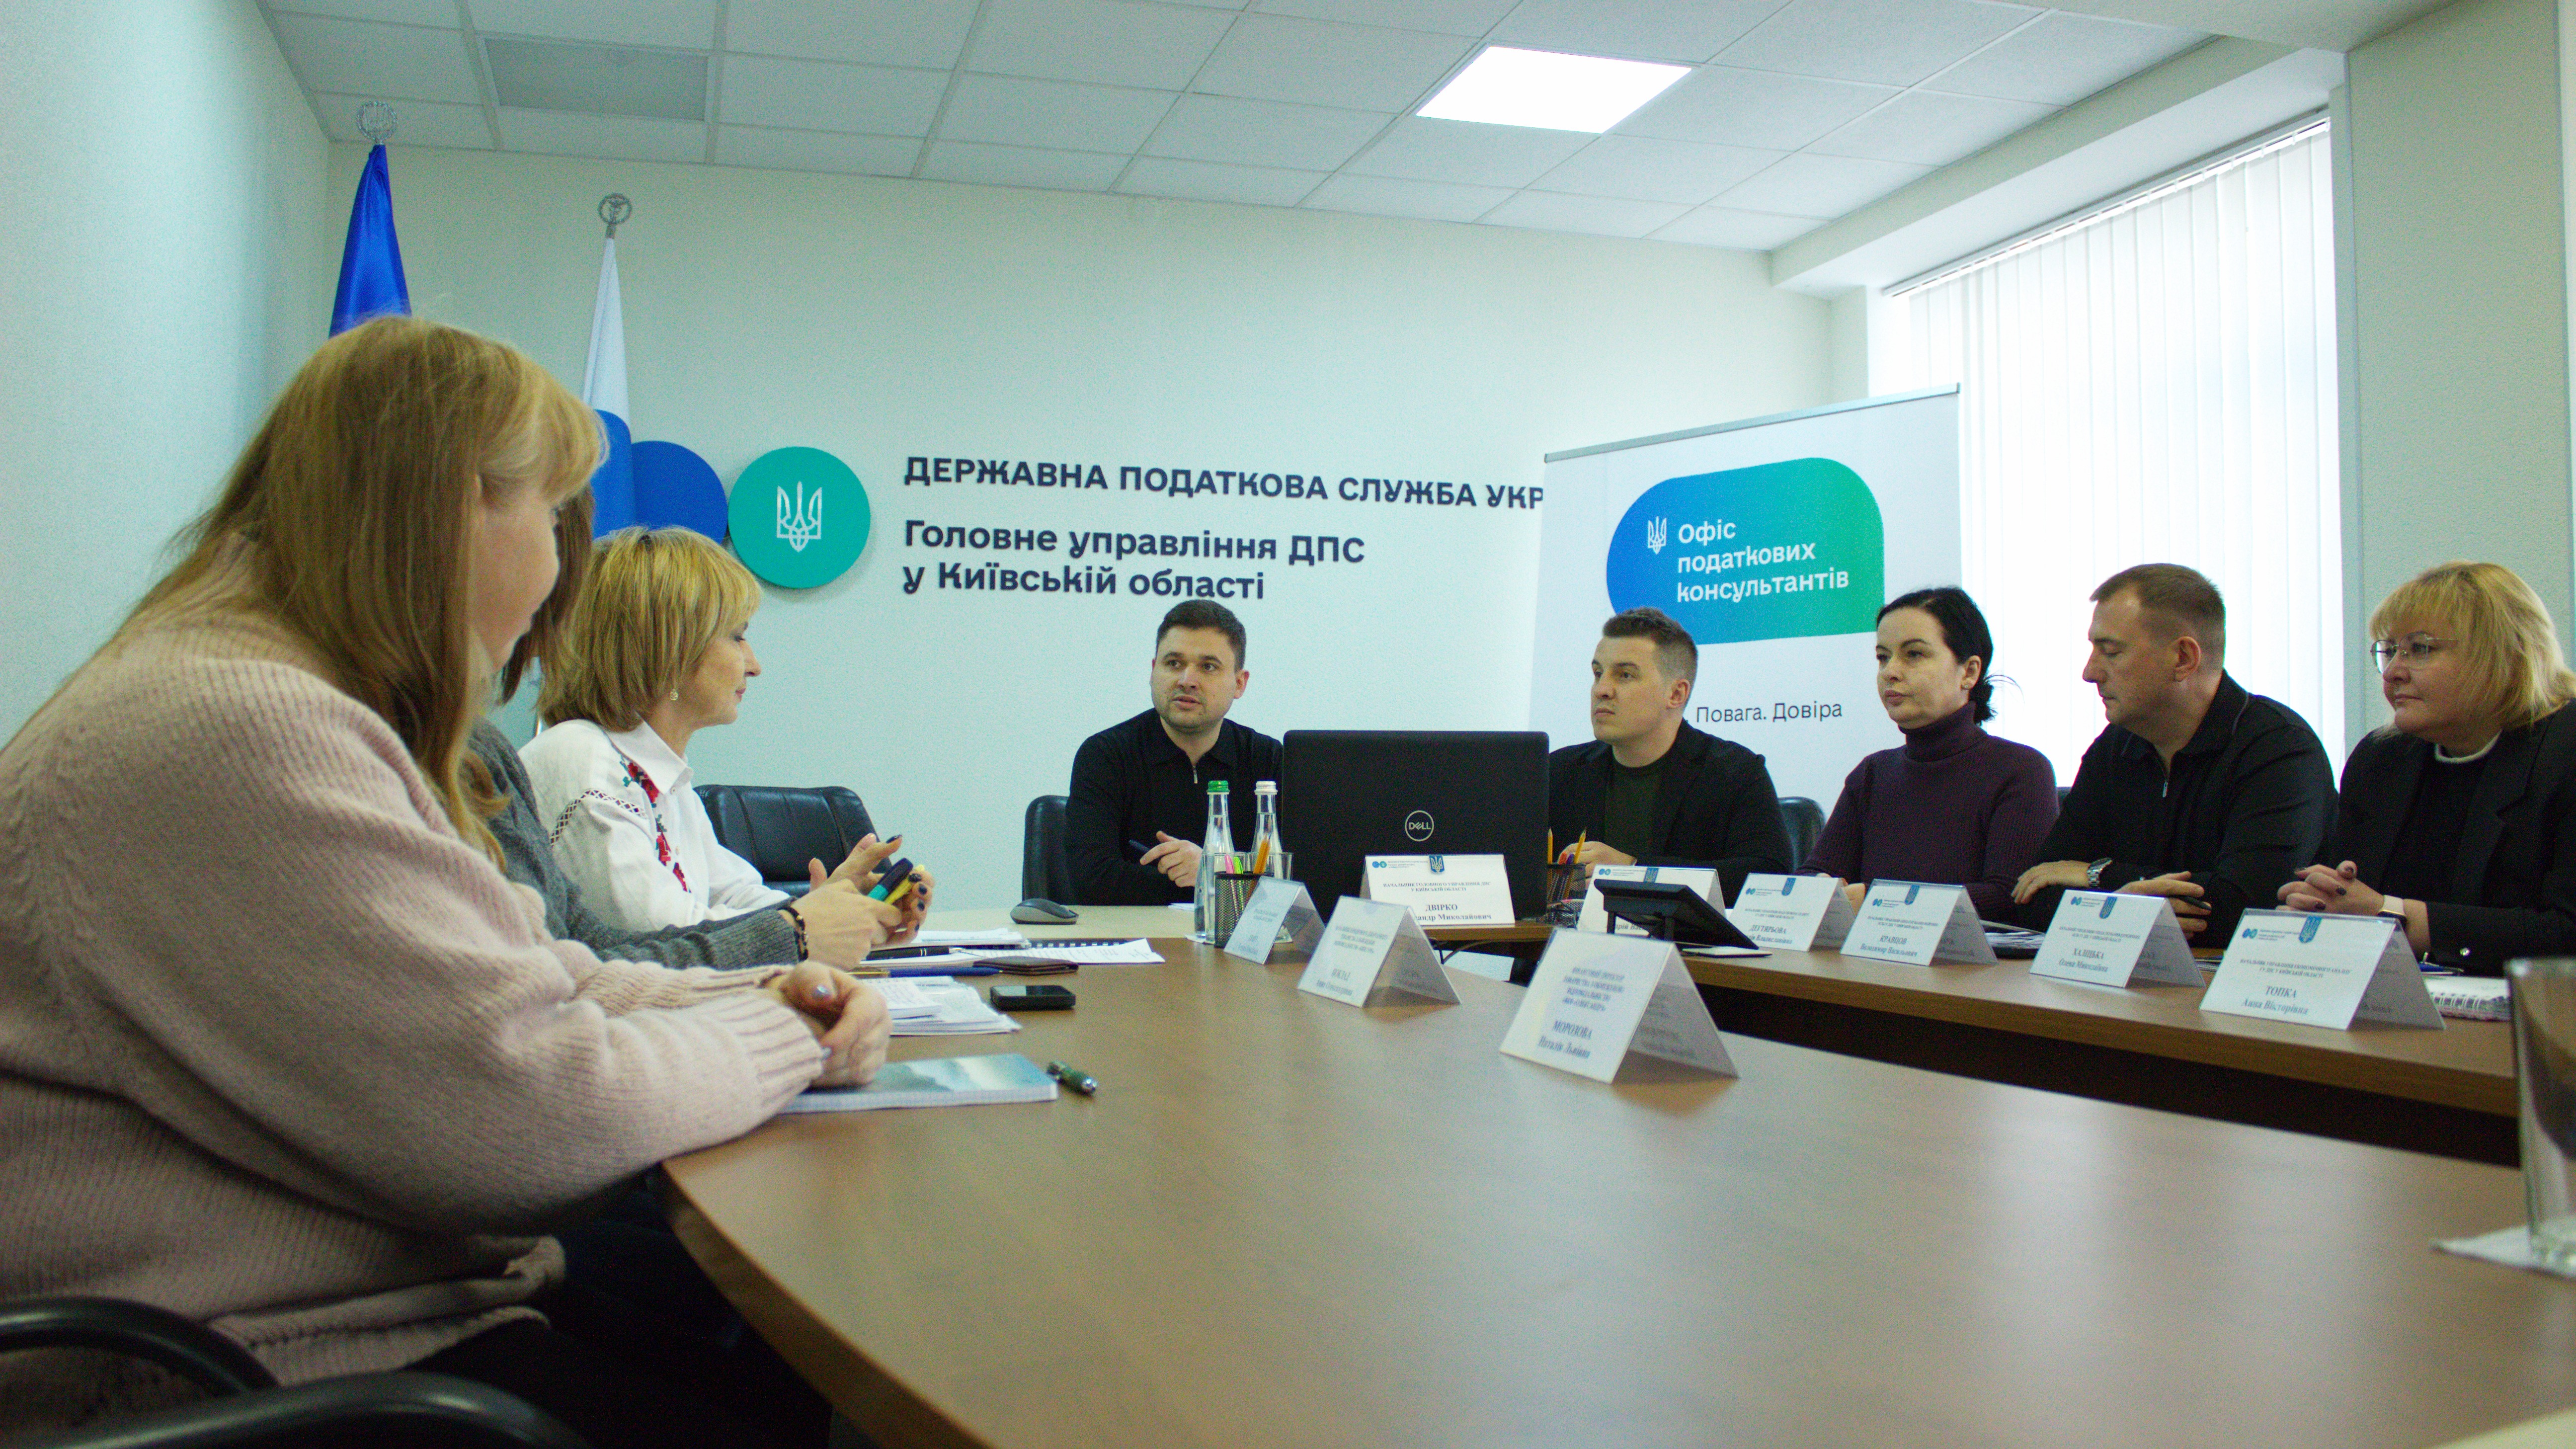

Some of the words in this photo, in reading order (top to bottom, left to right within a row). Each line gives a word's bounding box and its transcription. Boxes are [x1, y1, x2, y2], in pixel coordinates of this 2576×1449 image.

[904, 456, 1109, 489] ДЕРЖАВНА
[1120, 466, 1328, 499] ПОДАТКОВА
[1338, 478, 1477, 507] СЛУЖБА
[1486, 484, 1543, 509] УКР
[905, 520, 1058, 552] Головне
[1068, 530, 1277, 561] управління
[1288, 535, 1365, 566] ДПС
[1678, 519, 1736, 547] Офіс
[1678, 543, 1816, 574] податкових
[903, 566, 925, 595] у
[939, 562, 1117, 594] Київській
[1128, 568, 1264, 600] області
[1677, 566, 1850, 603] консультантів
[1696, 706, 1767, 723] Повага.
[1772, 701, 1843, 723] Довіра
[1409, 821, 1431, 830] DELL
[1425, 903, 1458, 912] ДВІРКО
[2242, 998, 2262, 1009] Анна
[2265, 985, 2298, 998] ТОПКА
